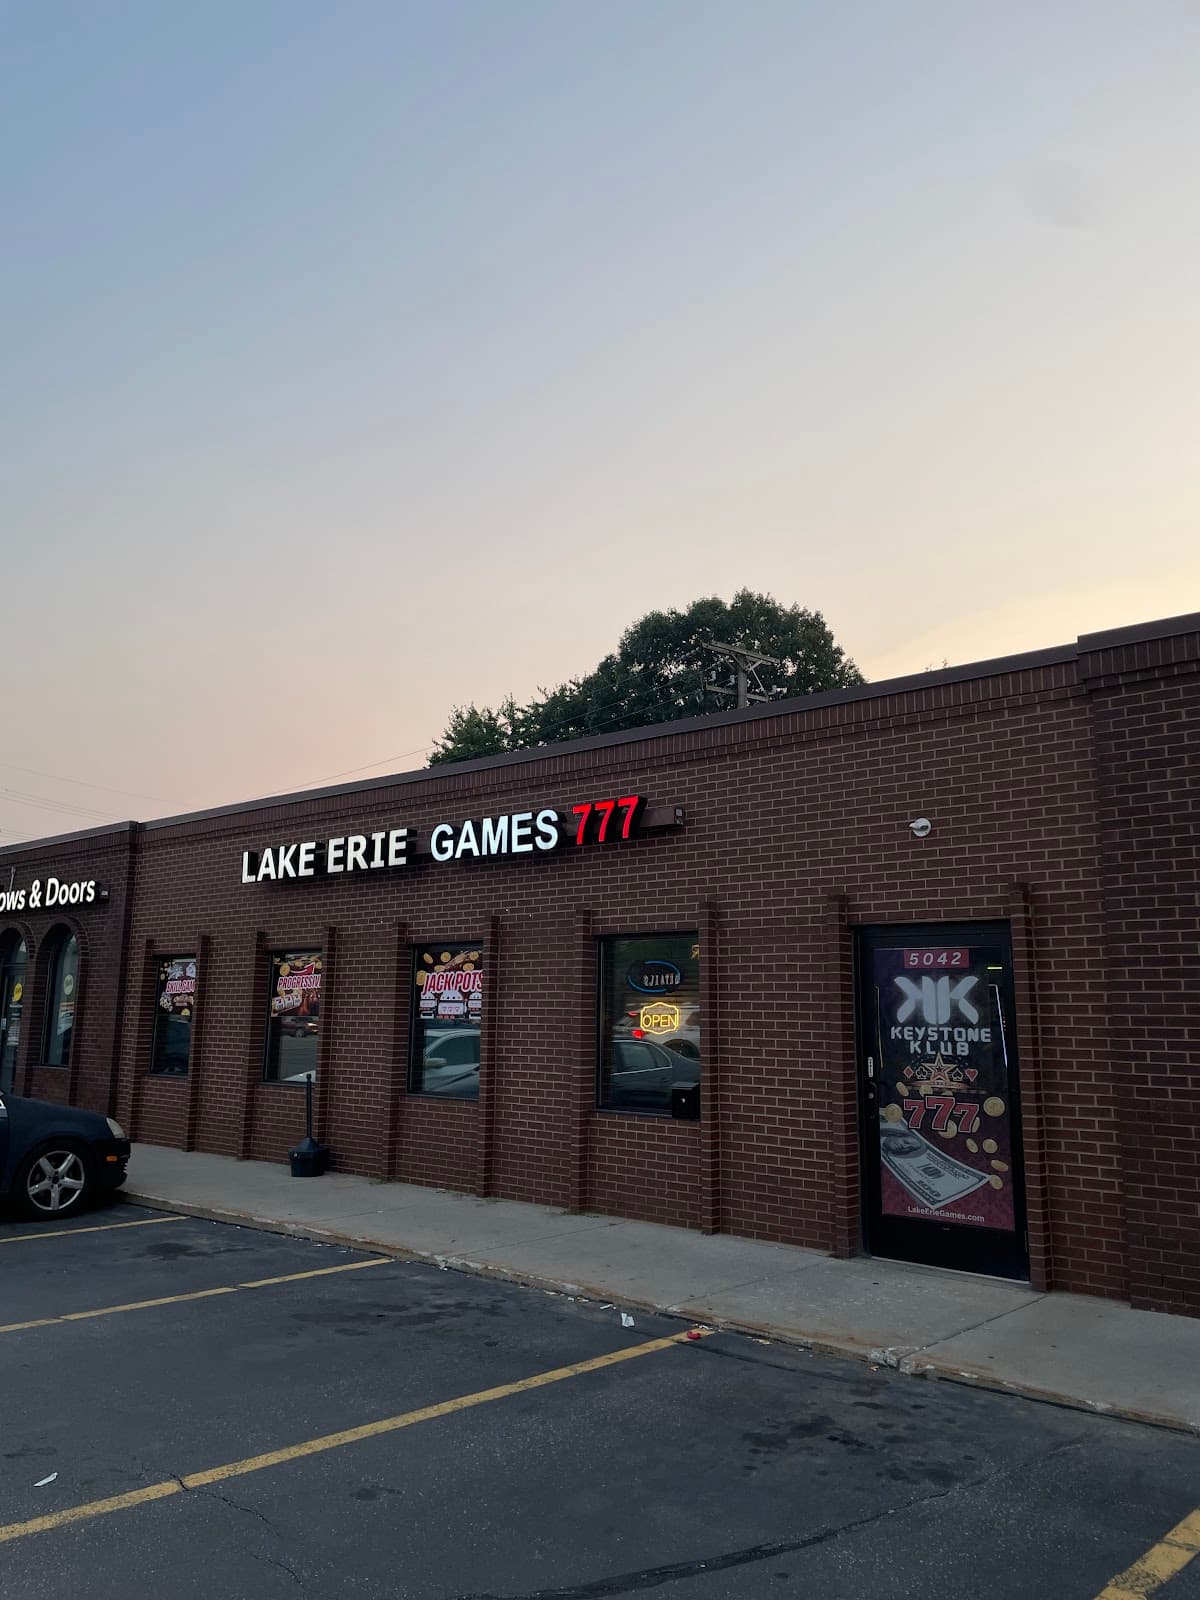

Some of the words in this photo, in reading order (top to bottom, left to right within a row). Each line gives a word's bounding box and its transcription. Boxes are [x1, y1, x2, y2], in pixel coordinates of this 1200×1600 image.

[241, 842, 316, 883] LAKE
[326, 828, 408, 873] ERIE
[430, 809, 560, 862] GAMES
[572, 795, 640, 845] 777
[29, 879, 42, 908] &
[45, 877, 96, 906] Doors
[908, 951, 962, 966] 5042
[422, 972, 456, 995] JACK
[643, 1014, 677, 1028] OPEN
[890, 1026, 992, 1043] KEYSTONE
[909, 1040, 970, 1057] KLUB
[903, 1094, 980, 1134] 777
[907, 1205, 985, 1222] LakeErieGames.com
